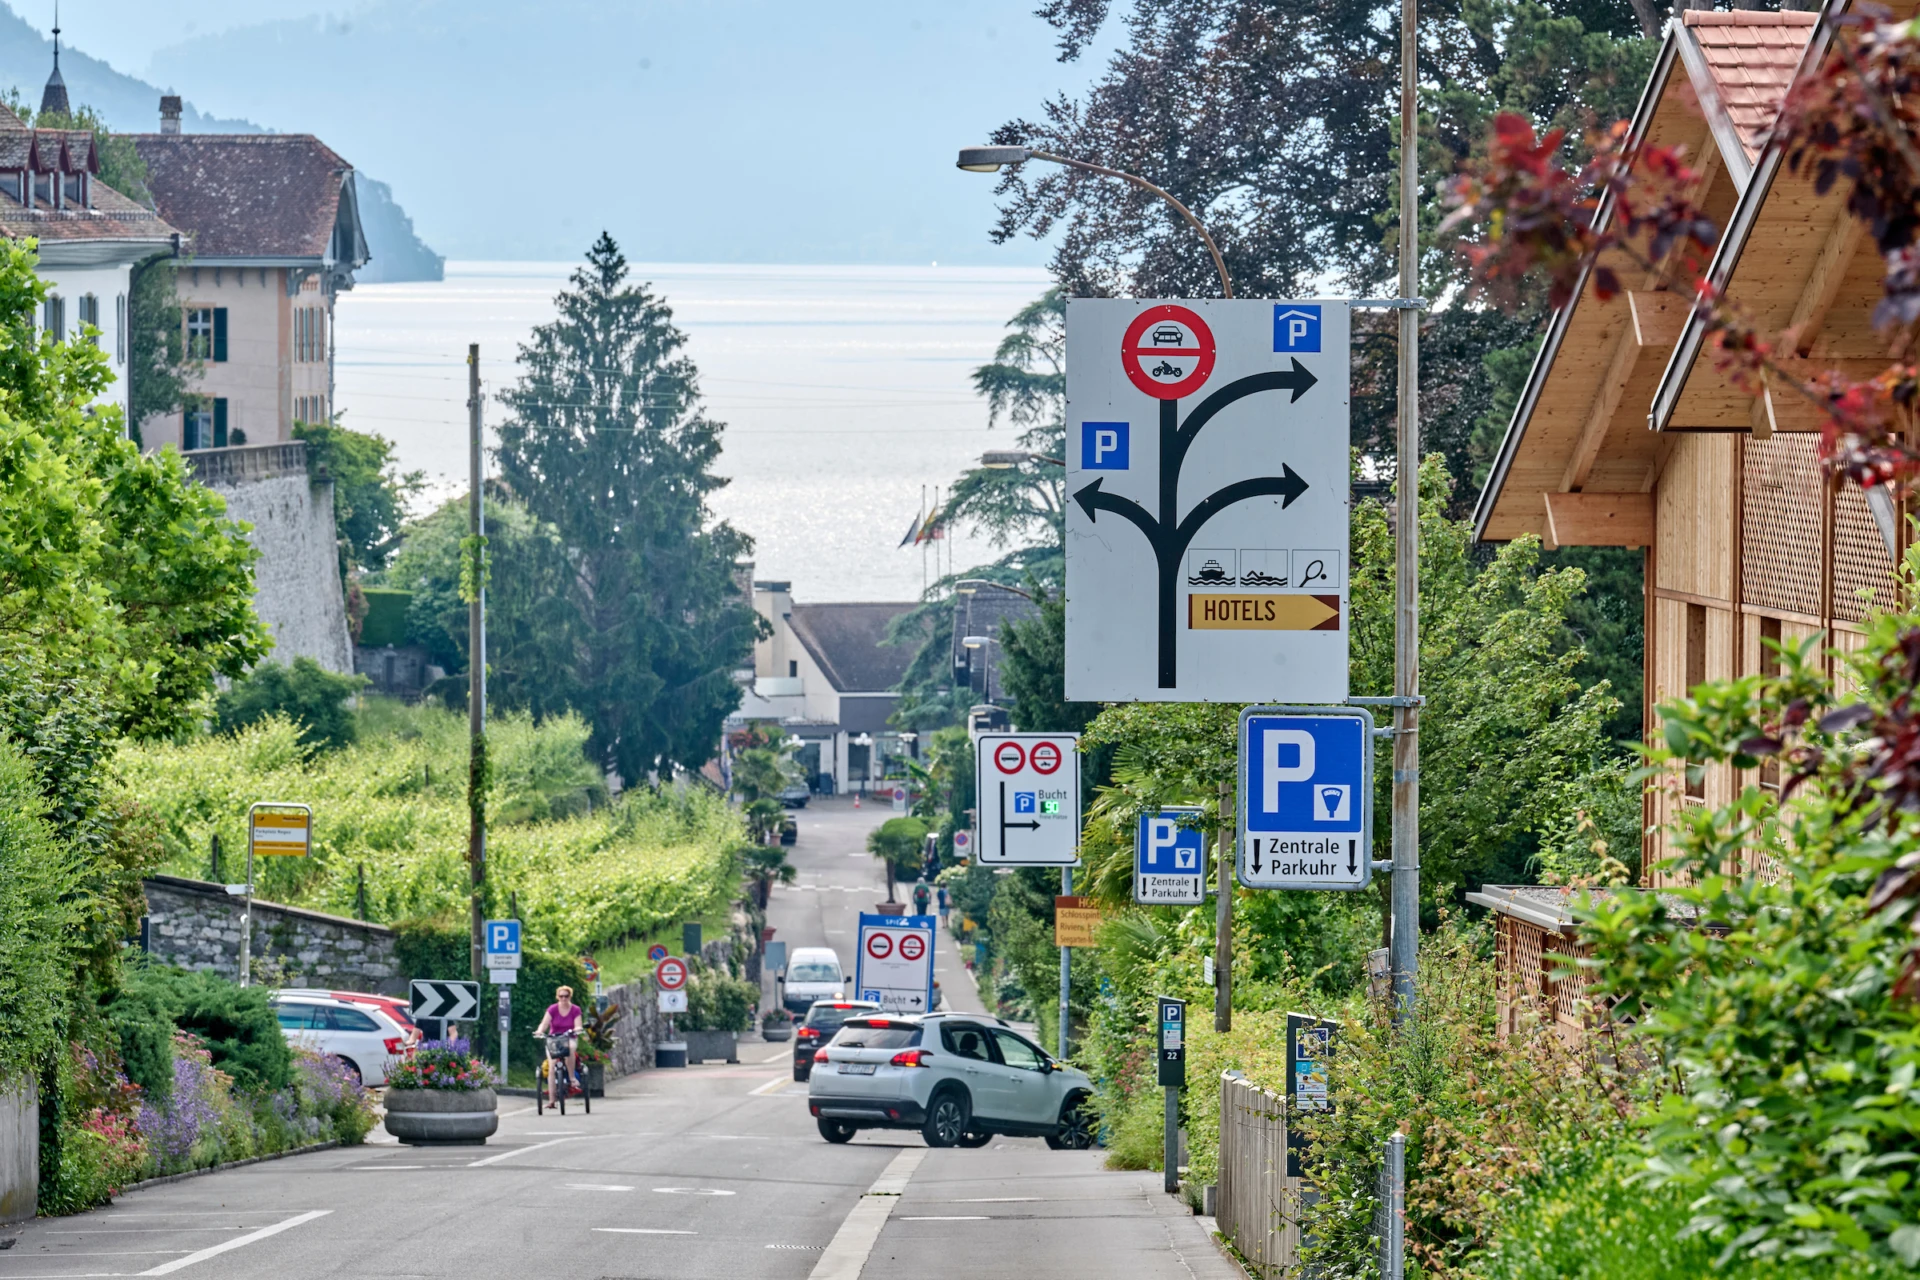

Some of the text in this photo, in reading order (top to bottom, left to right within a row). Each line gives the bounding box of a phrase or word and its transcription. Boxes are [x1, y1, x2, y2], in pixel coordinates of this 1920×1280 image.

[1289, 319, 1307, 346] P
[1096, 430, 1118, 463] P
[1204, 599, 1276, 621] HOTELS
[1263, 729, 1316, 813] P
[1038, 789, 1067, 800] Bucht
[1020, 798, 1029, 811] P
[1045, 801, 1059, 814] 90
[1147, 818, 1177, 864] P
[1269, 838, 1340, 854] Zentrale
[1272, 859, 1337, 875] Parkuhr
[1151, 877, 1190, 887] Zentrale
[1152, 888, 1188, 898] Parkuhr
[493, 925, 509, 949] P
[883, 995, 906, 1004] Bucht
[1167, 1006, 1178, 1020] P
[1167, 1051, 1178, 1060] 22
